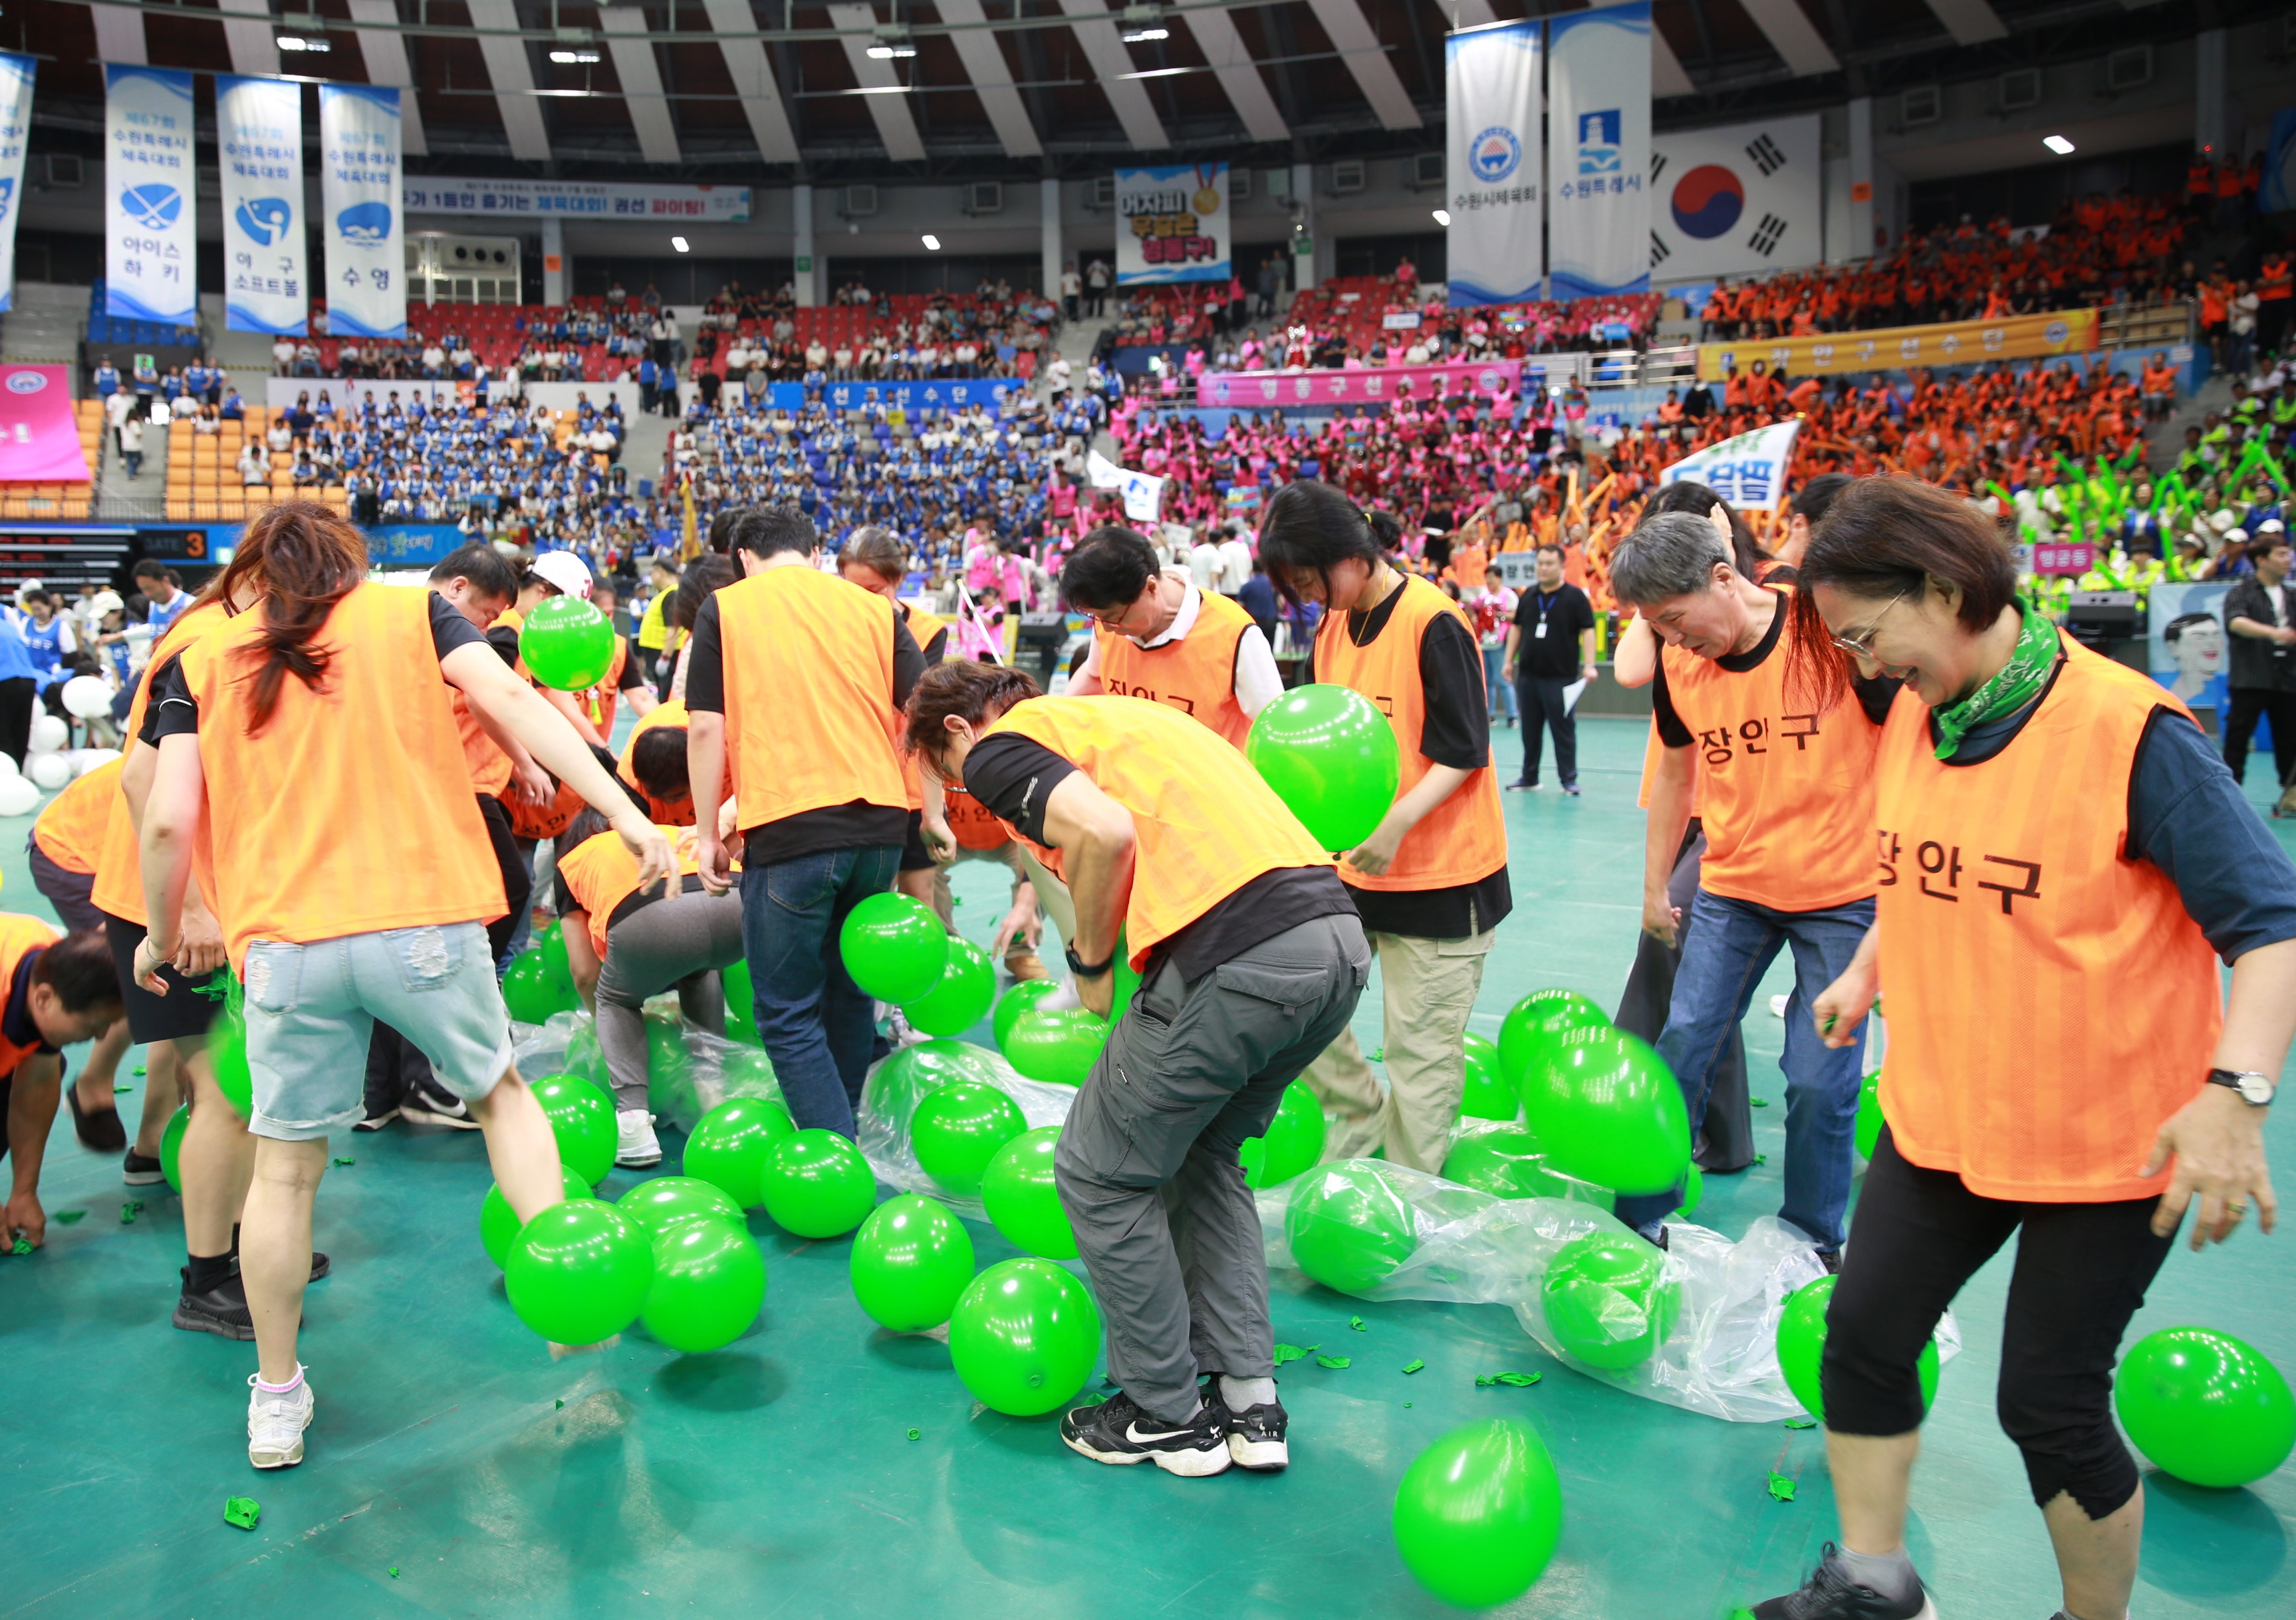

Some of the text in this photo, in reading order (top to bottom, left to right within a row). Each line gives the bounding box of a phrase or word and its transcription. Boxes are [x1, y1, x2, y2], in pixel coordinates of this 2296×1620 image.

[113, 129, 188, 150] 수원특례시
[225, 142, 295, 160] 수원특례시
[121, 148, 181, 168] 체육대회
[328, 150, 396, 166] 수원특례시
[233, 162, 289, 179] 체육대회
[336, 168, 391, 185] 체육대회
[1454, 185, 1537, 211] 수원시체육회
[1559, 174, 1640, 200] 수원특례시
[122, 236, 181, 260] 아이스
[1142, 236, 1216, 263] 영통구!
[234, 273, 298, 298] 소프트볼
[186, 532, 205, 558] 3
[1698, 714, 1820, 765] 장안구
